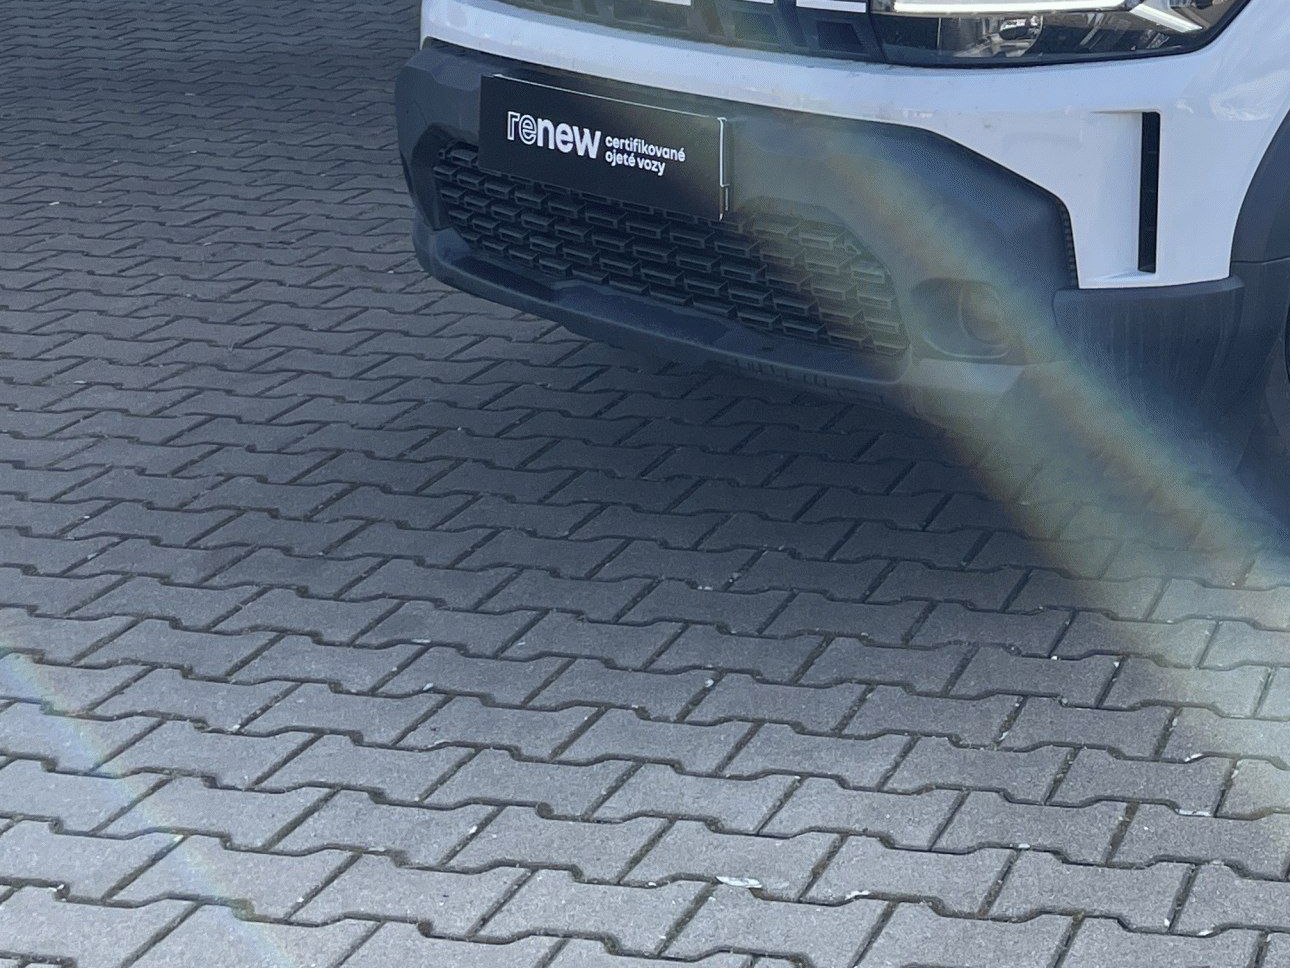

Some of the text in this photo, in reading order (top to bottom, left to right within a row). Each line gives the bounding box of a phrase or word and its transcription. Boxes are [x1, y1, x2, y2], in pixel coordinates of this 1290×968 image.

[507, 111, 601, 159] renew
[605, 136, 686, 162] certifikované
[605, 149, 666, 176] ojeté vozy
